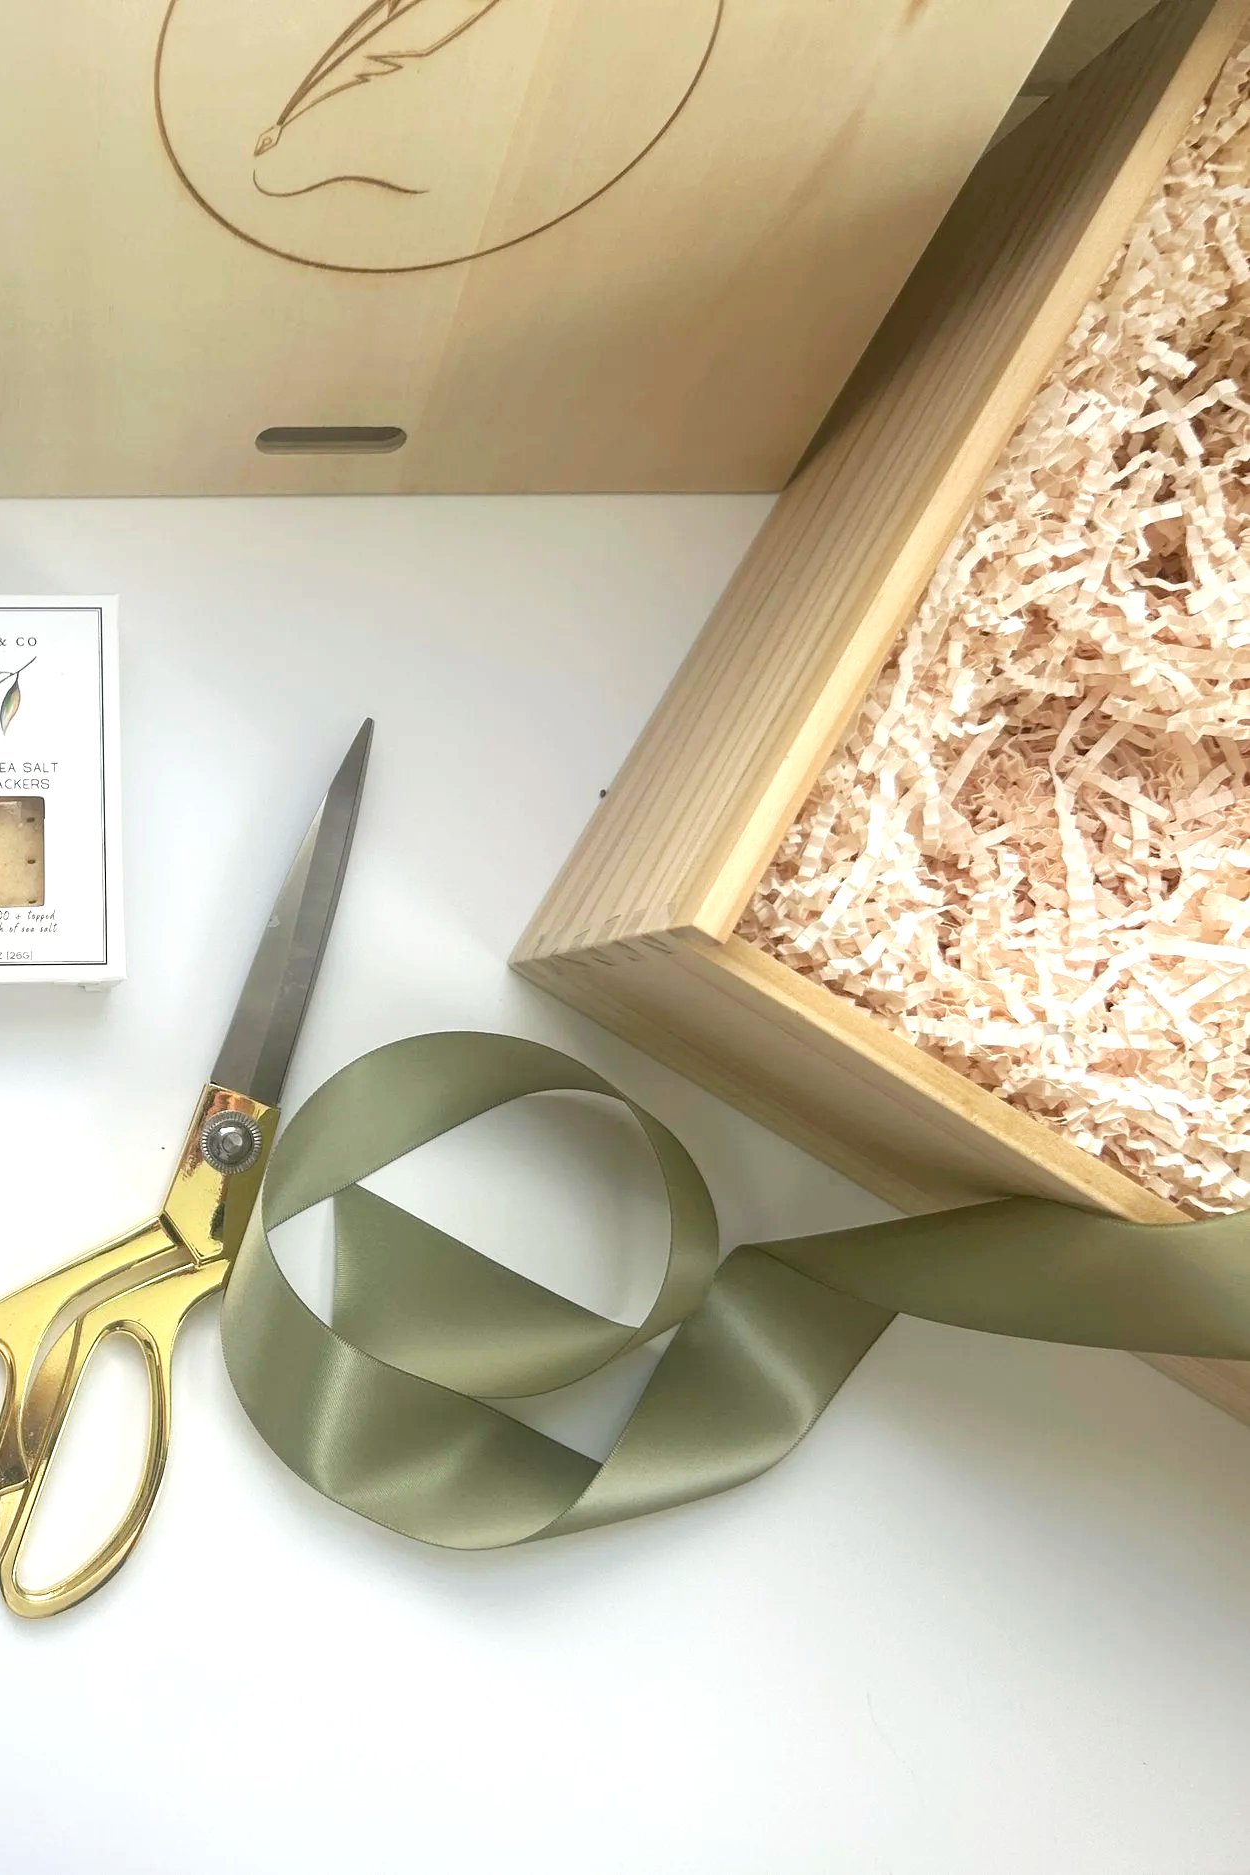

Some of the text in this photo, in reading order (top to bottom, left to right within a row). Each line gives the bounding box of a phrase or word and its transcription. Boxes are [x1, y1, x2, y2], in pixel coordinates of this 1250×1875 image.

[16, 637, 37, 646] CO
[23, 762, 58, 773] SALT
[27, 909, 56, 922] topped
[9, 923, 19, 933] of
[40, 923, 57, 933] salt
